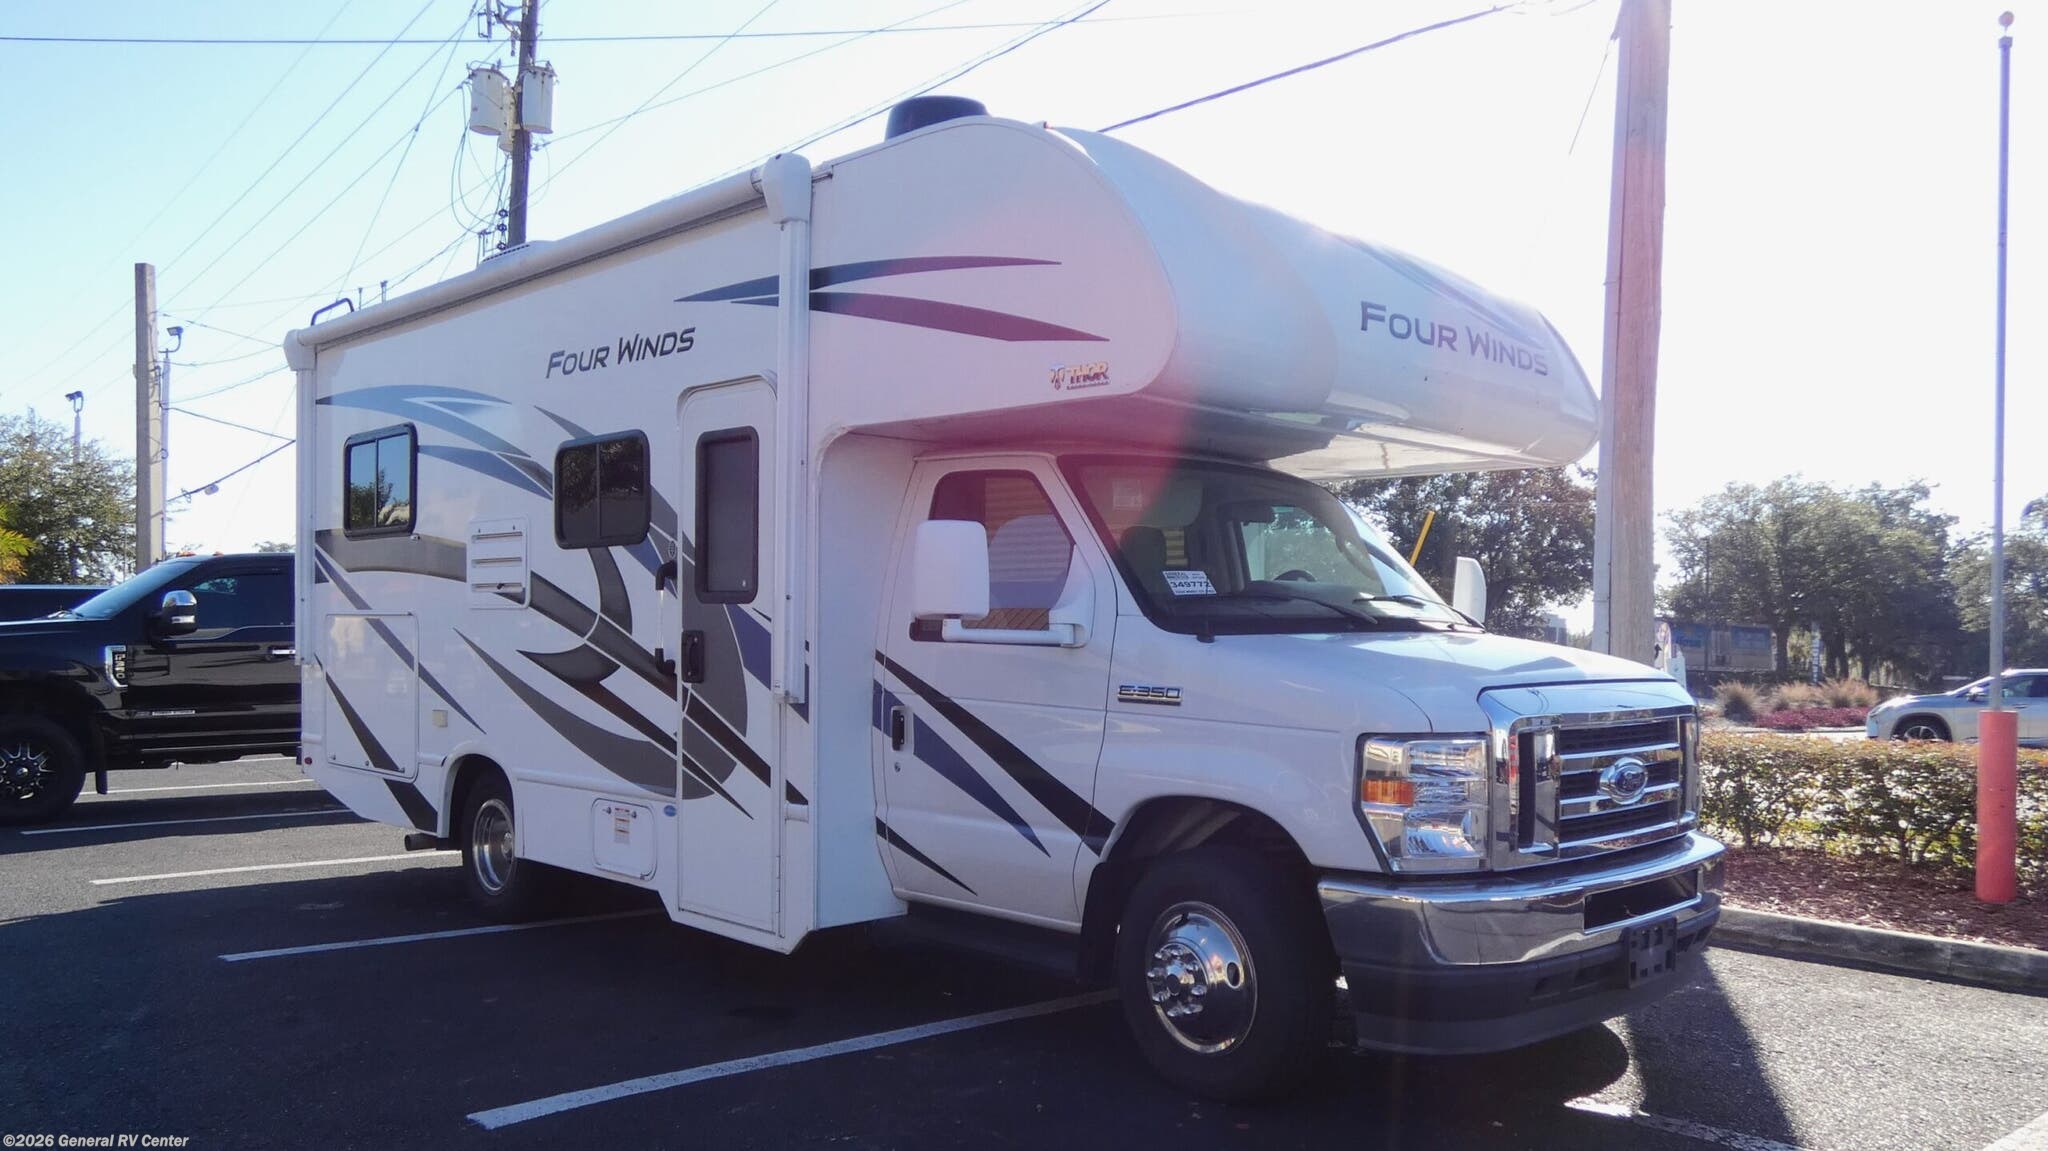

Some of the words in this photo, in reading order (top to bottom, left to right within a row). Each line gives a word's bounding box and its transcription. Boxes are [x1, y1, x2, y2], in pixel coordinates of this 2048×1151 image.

[545, 346, 610, 379] FOUR
[617, 327, 696, 365] WINDS
[1361, 301, 1458, 352] FOUR
[1466, 326, 1549, 376] WINDS
[1066, 361, 1110, 385] THOR
